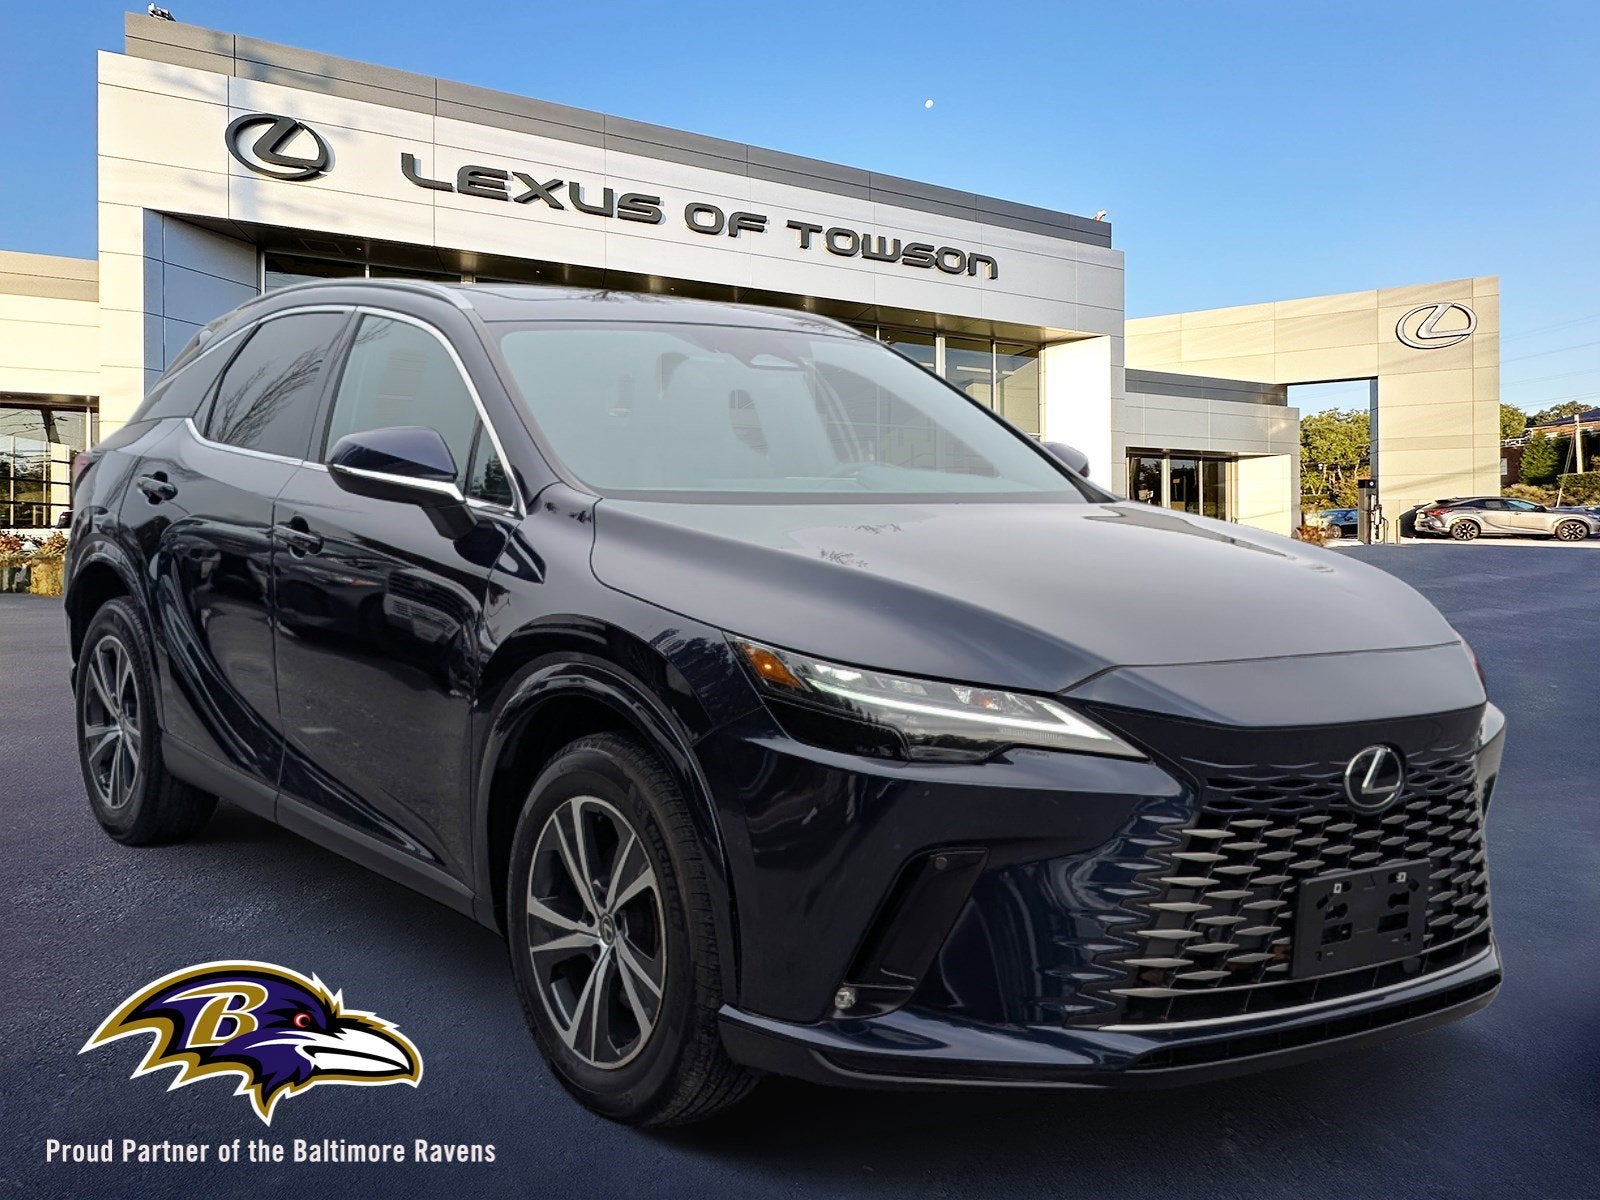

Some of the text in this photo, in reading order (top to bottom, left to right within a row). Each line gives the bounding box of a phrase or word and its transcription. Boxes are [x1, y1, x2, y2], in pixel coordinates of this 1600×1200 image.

[401, 152, 998, 280] LEXUS OF TOWSON
